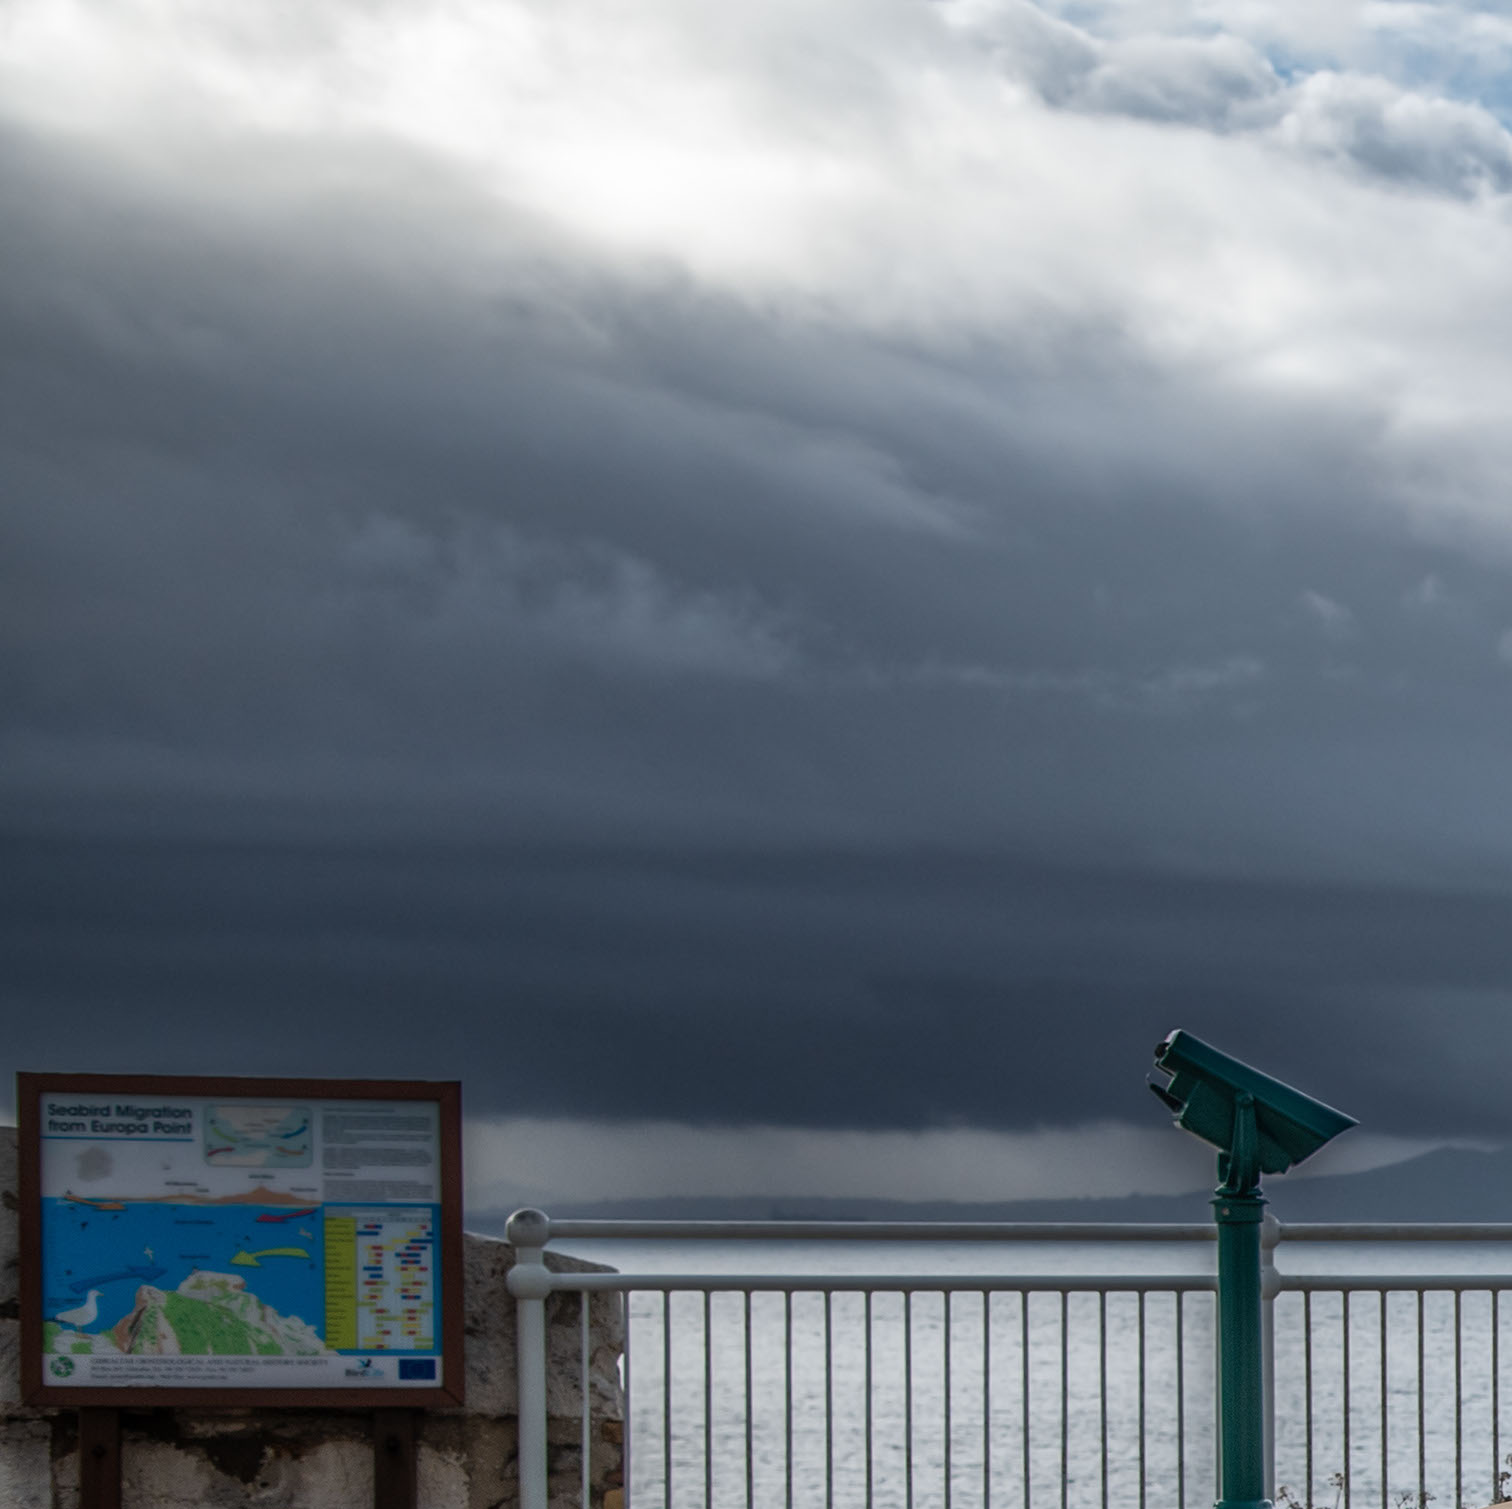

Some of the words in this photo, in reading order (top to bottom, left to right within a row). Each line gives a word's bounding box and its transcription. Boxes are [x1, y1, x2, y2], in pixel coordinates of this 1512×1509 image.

[47, 1103, 110, 1117] Seabird
[116, 1104, 192, 1121] Migration
[48, 1120, 86, 1132] from
[91, 1120, 148, 1135] Europa
[153, 1121, 192, 1134] Point
